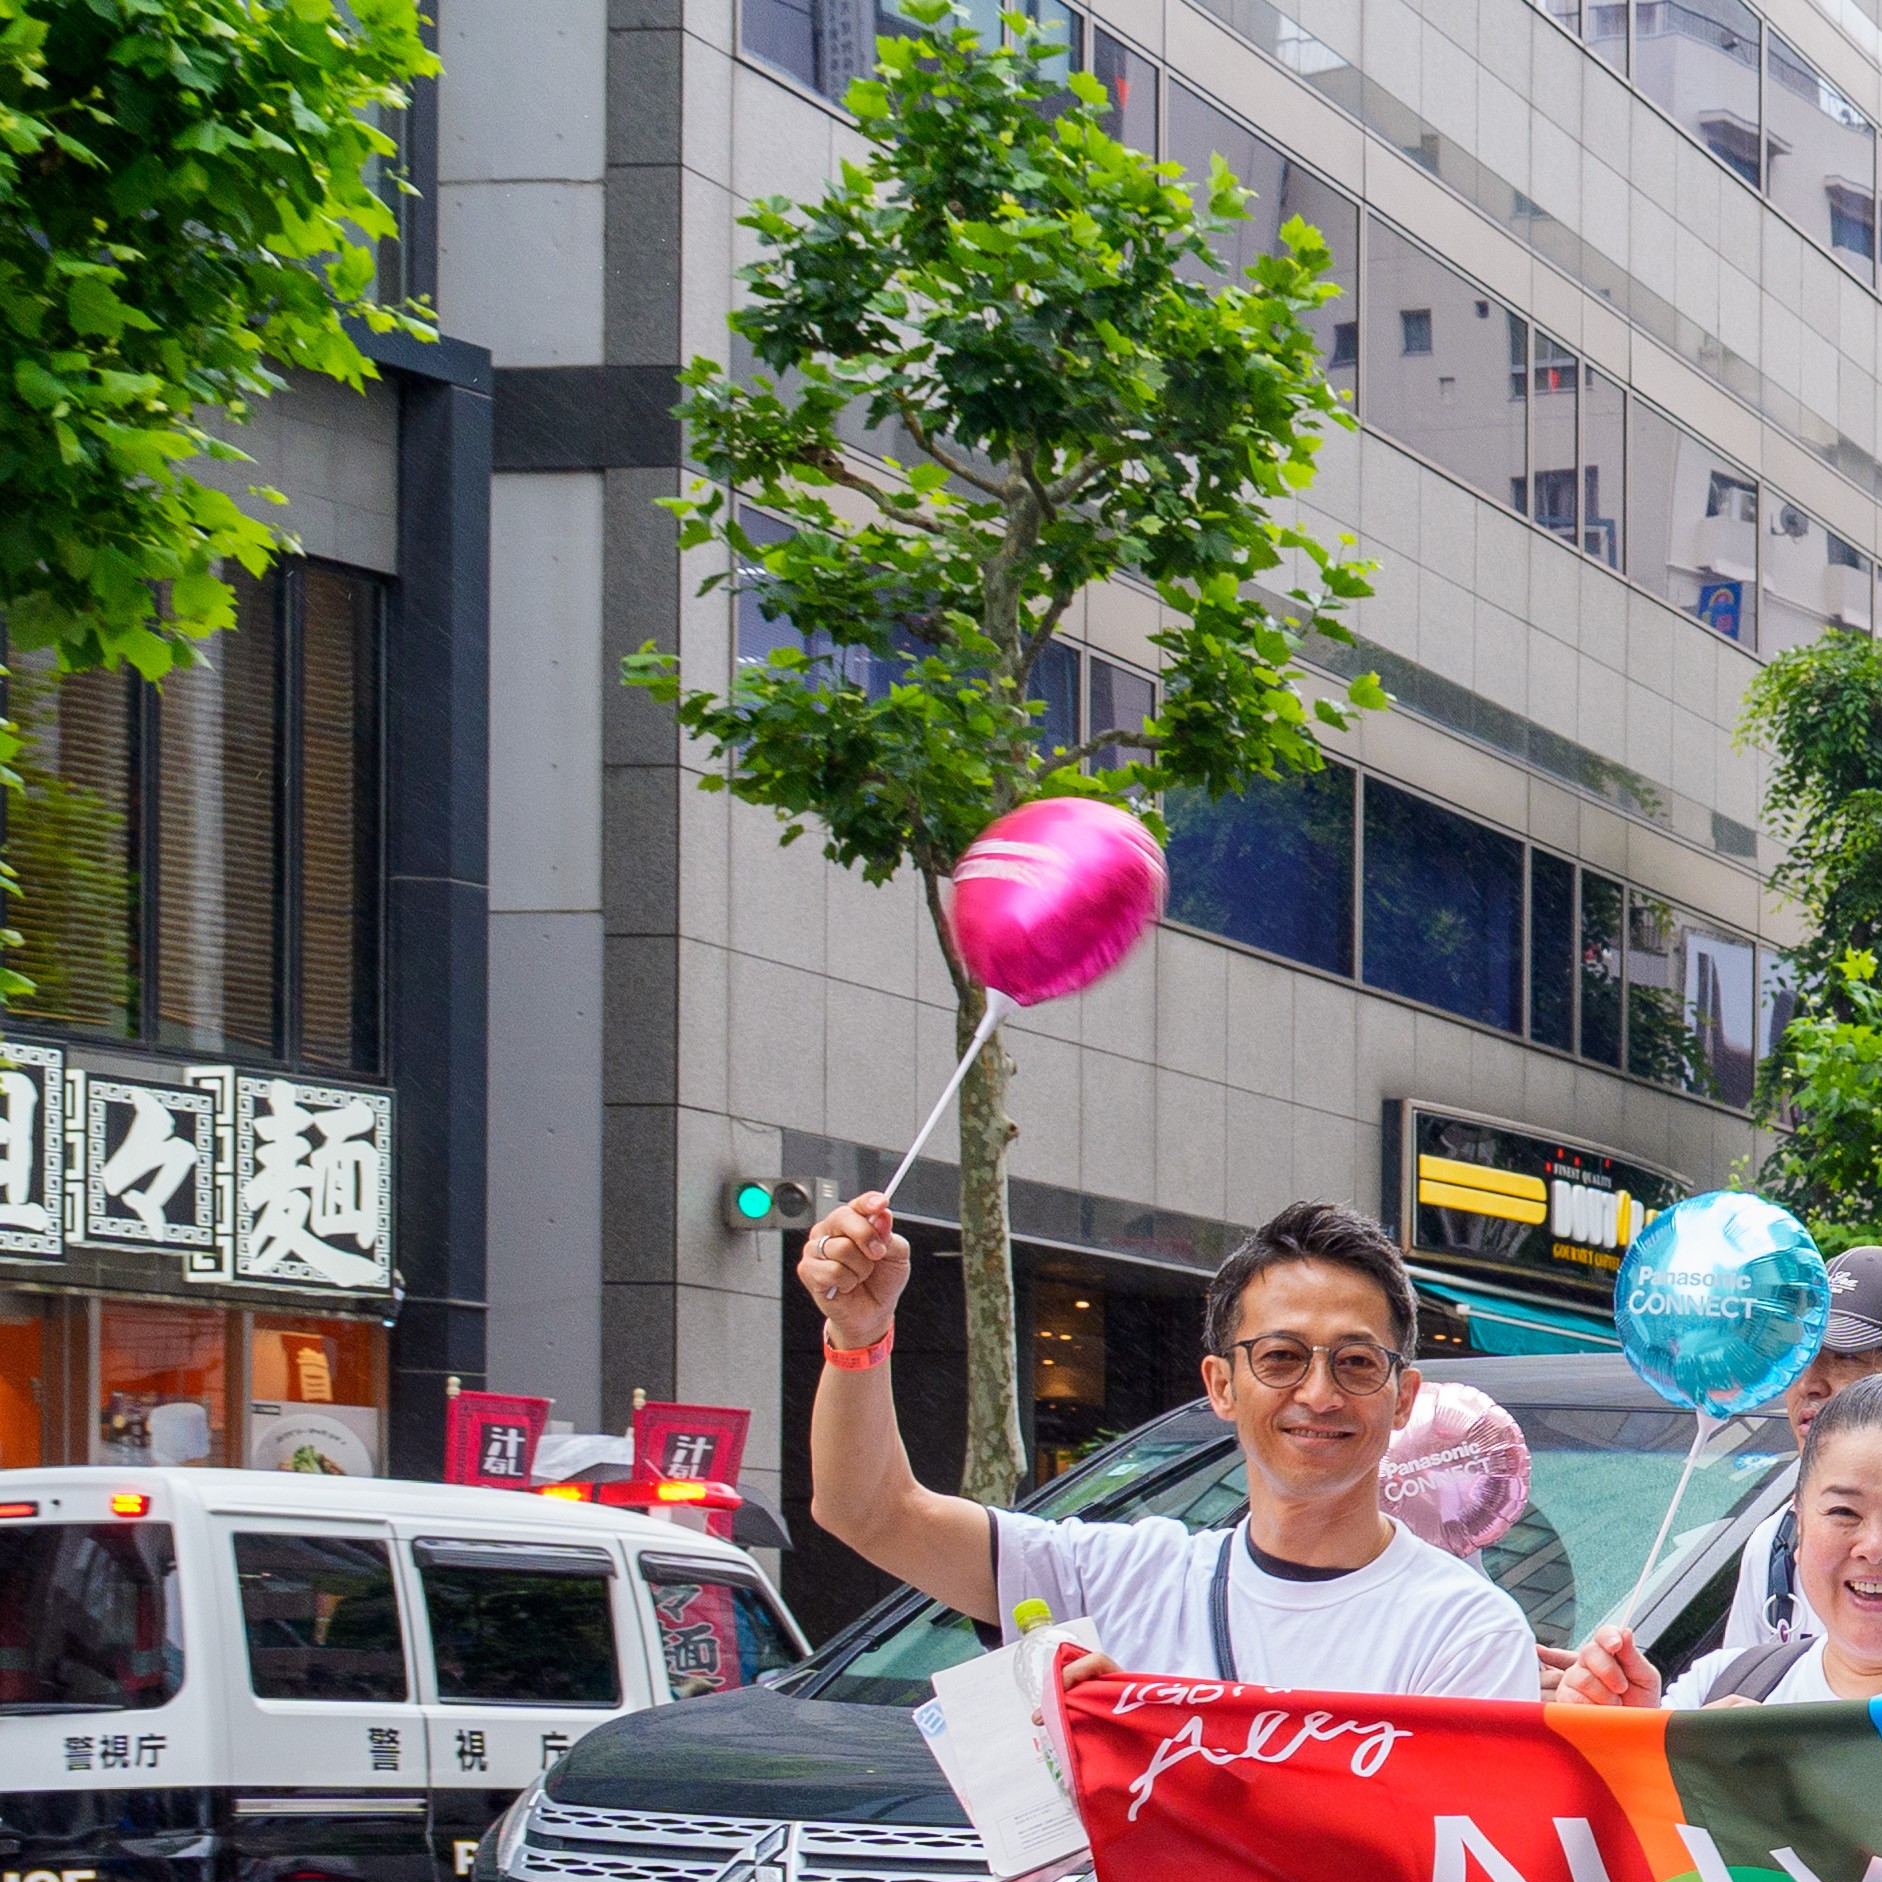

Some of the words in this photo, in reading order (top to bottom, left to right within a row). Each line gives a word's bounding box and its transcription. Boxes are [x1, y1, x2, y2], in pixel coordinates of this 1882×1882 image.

[1637, 1264, 1753, 1291] Panasonic
[1627, 1289, 1759, 1320] CONNECT
[1384, 1438, 1481, 1480] Panasonic
[1384, 1456, 1492, 1503] CONNECT
[63, 1735, 168, 1773] 警視庁
